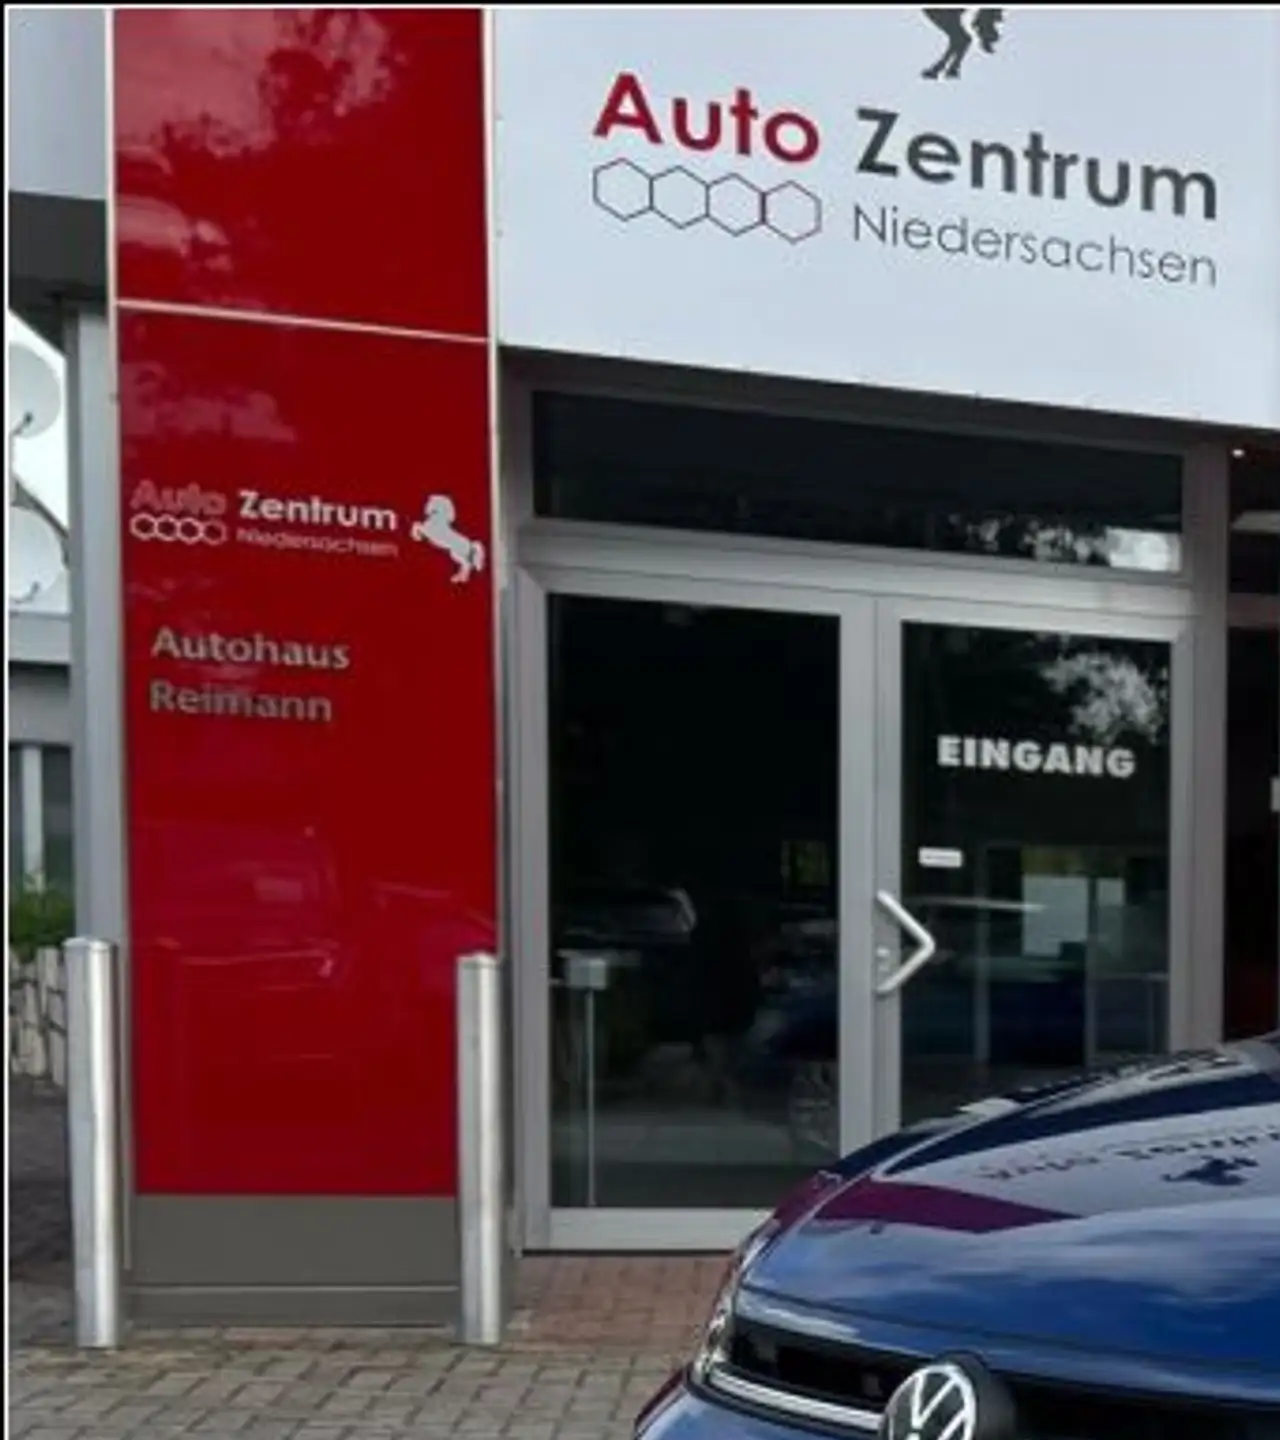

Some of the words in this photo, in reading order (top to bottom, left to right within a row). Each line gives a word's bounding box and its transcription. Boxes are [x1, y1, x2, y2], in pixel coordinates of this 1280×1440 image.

[592, 71, 822, 164] Auto
[855, 107, 1219, 220] Zentrum
[852, 204, 1219, 287] Niedersachsen
[130, 479, 226, 515] Auto
[238, 490, 398, 533] Zentrum
[235, 527, 399, 559] Niedersachsen
[151, 626, 350, 672] Autohaus
[150, 681, 332, 722] Reimann
[936, 734, 1137, 778] EINGANG
